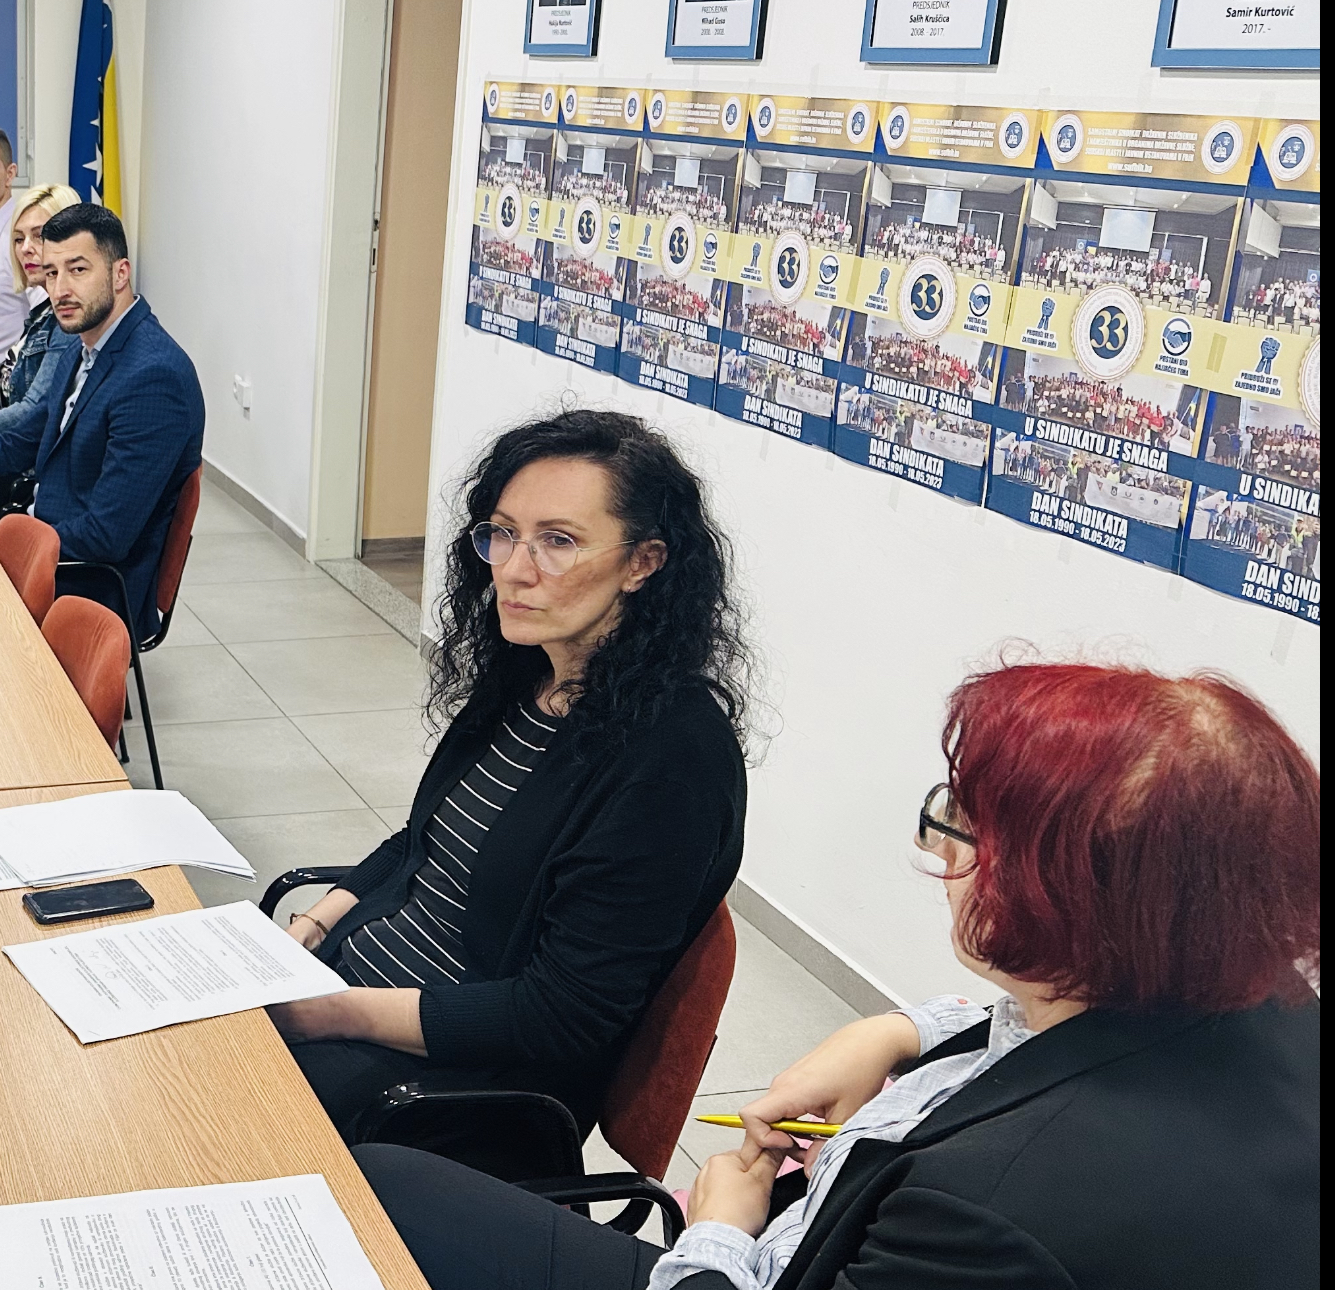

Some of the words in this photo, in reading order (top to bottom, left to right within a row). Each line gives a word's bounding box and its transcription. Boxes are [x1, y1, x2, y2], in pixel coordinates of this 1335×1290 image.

[1226, 7, 1252, 17] Samir
[1254, 6, 1295, 16] Kurtović
[1242, 24, 1266, 33] 2017.
[578, 214, 596, 240] 33
[669, 226, 688, 257] 33
[778, 251, 799, 282] 33
[912, 277, 942, 313] 33
[642, 310, 678, 332] SINDIKATU
[678, 319, 685, 333] JE
[685, 322, 707, 340] SNAGA
[1090, 310, 1127, 350] 33
[742, 337, 748, 351] U
[748, 337, 787, 363] SINDIKATU
[787, 350, 796, 365] JE
[797, 353, 823, 374] SNAGA
[640, 361, 655, 377] DAN
[656, 365, 688, 389] SINDIKATA
[744, 395, 762, 413] DAN
[762, 400, 802, 427] SINDIKATA
[865, 372, 872, 389] U
[872, 373, 927, 403] SINDIKATU
[927, 389, 938, 408] JE
[939, 393, 972, 418] SNAGA
[870, 438, 891, 459] DAN
[892, 444, 944, 477] SINDIKATA
[1024, 417, 1035, 435] U
[1036, 420, 1106, 456] SINDIKATU
[1106, 437, 1121, 459] JE
[1122, 442, 1168, 472] SNAGA
[1239, 474, 1252, 496] U
[1253, 478, 1320, 517] SINDIKA
[1031, 491, 1060, 516] DAN
[1061, 499, 1128, 538] SINDIKATA
[1030, 511, 1075, 535] 18.05.1990
[1080, 527, 1126, 552] 18.05.2023
[1244, 560, 1281, 590] DAN
[1241, 583, 1299, 613] 18.05.1990
